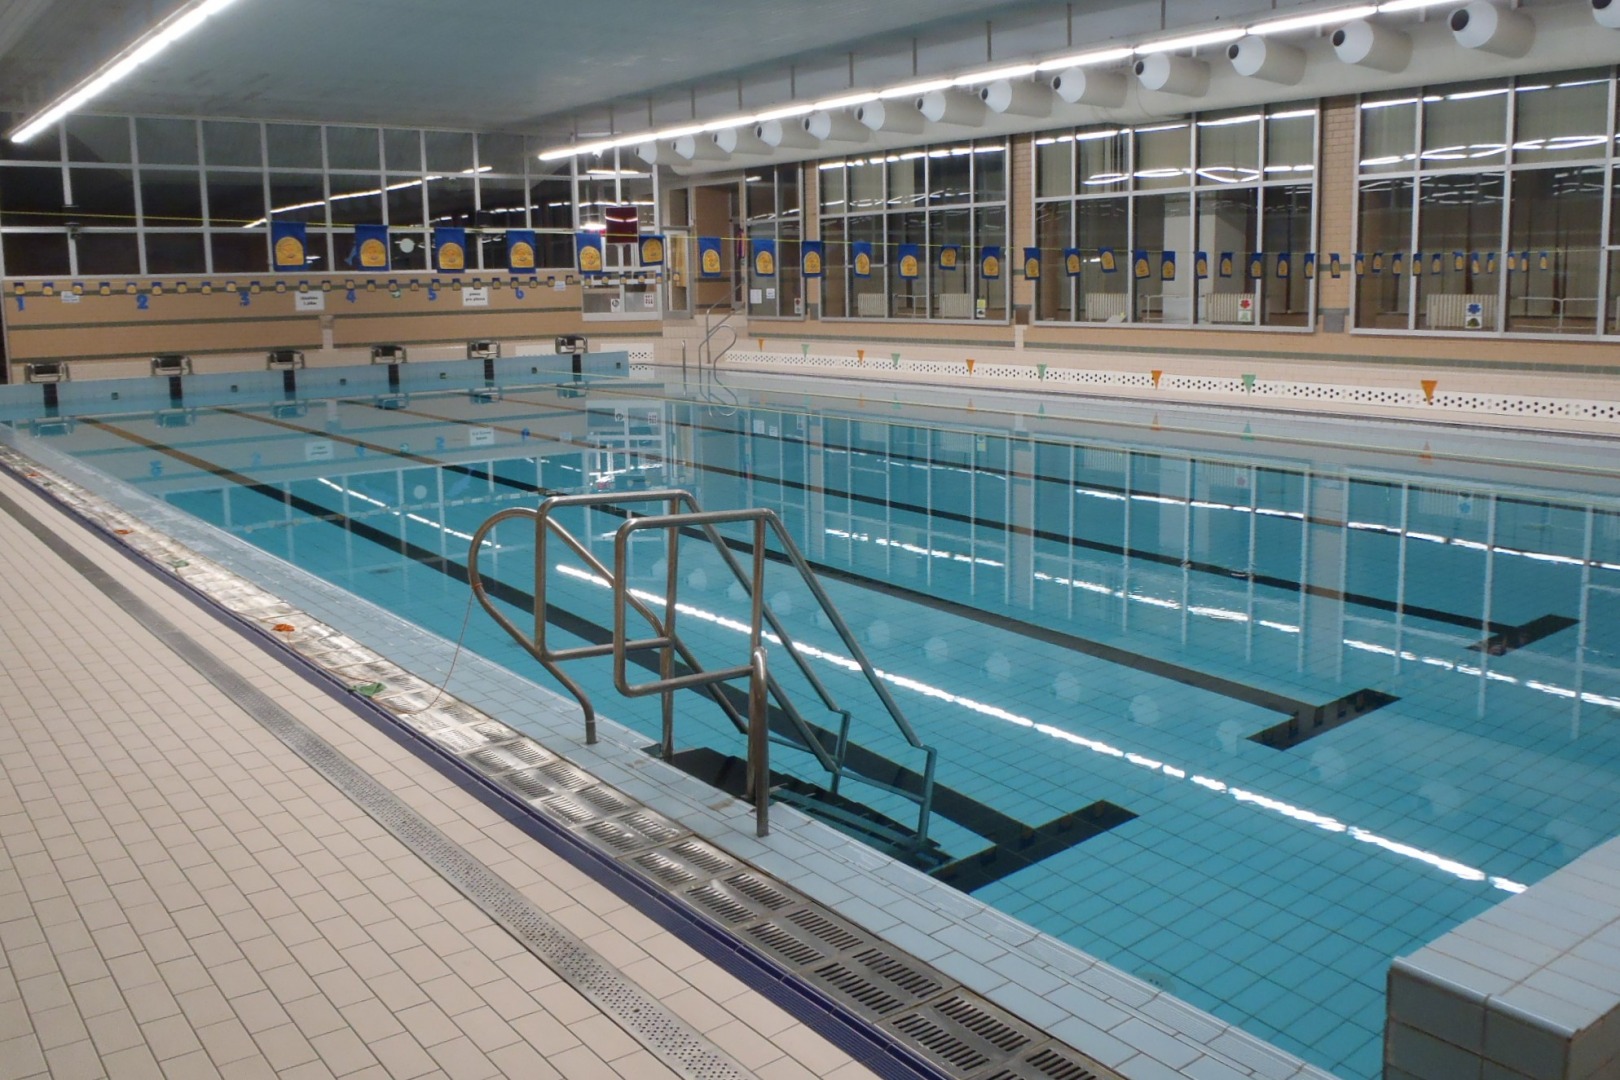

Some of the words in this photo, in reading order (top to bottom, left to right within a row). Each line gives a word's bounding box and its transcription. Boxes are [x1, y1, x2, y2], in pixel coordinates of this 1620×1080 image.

[239, 290, 250, 306] 3
[428, 287, 437, 301] 5
[515, 288, 524, 299] 6
[137, 294, 149, 309] 2
